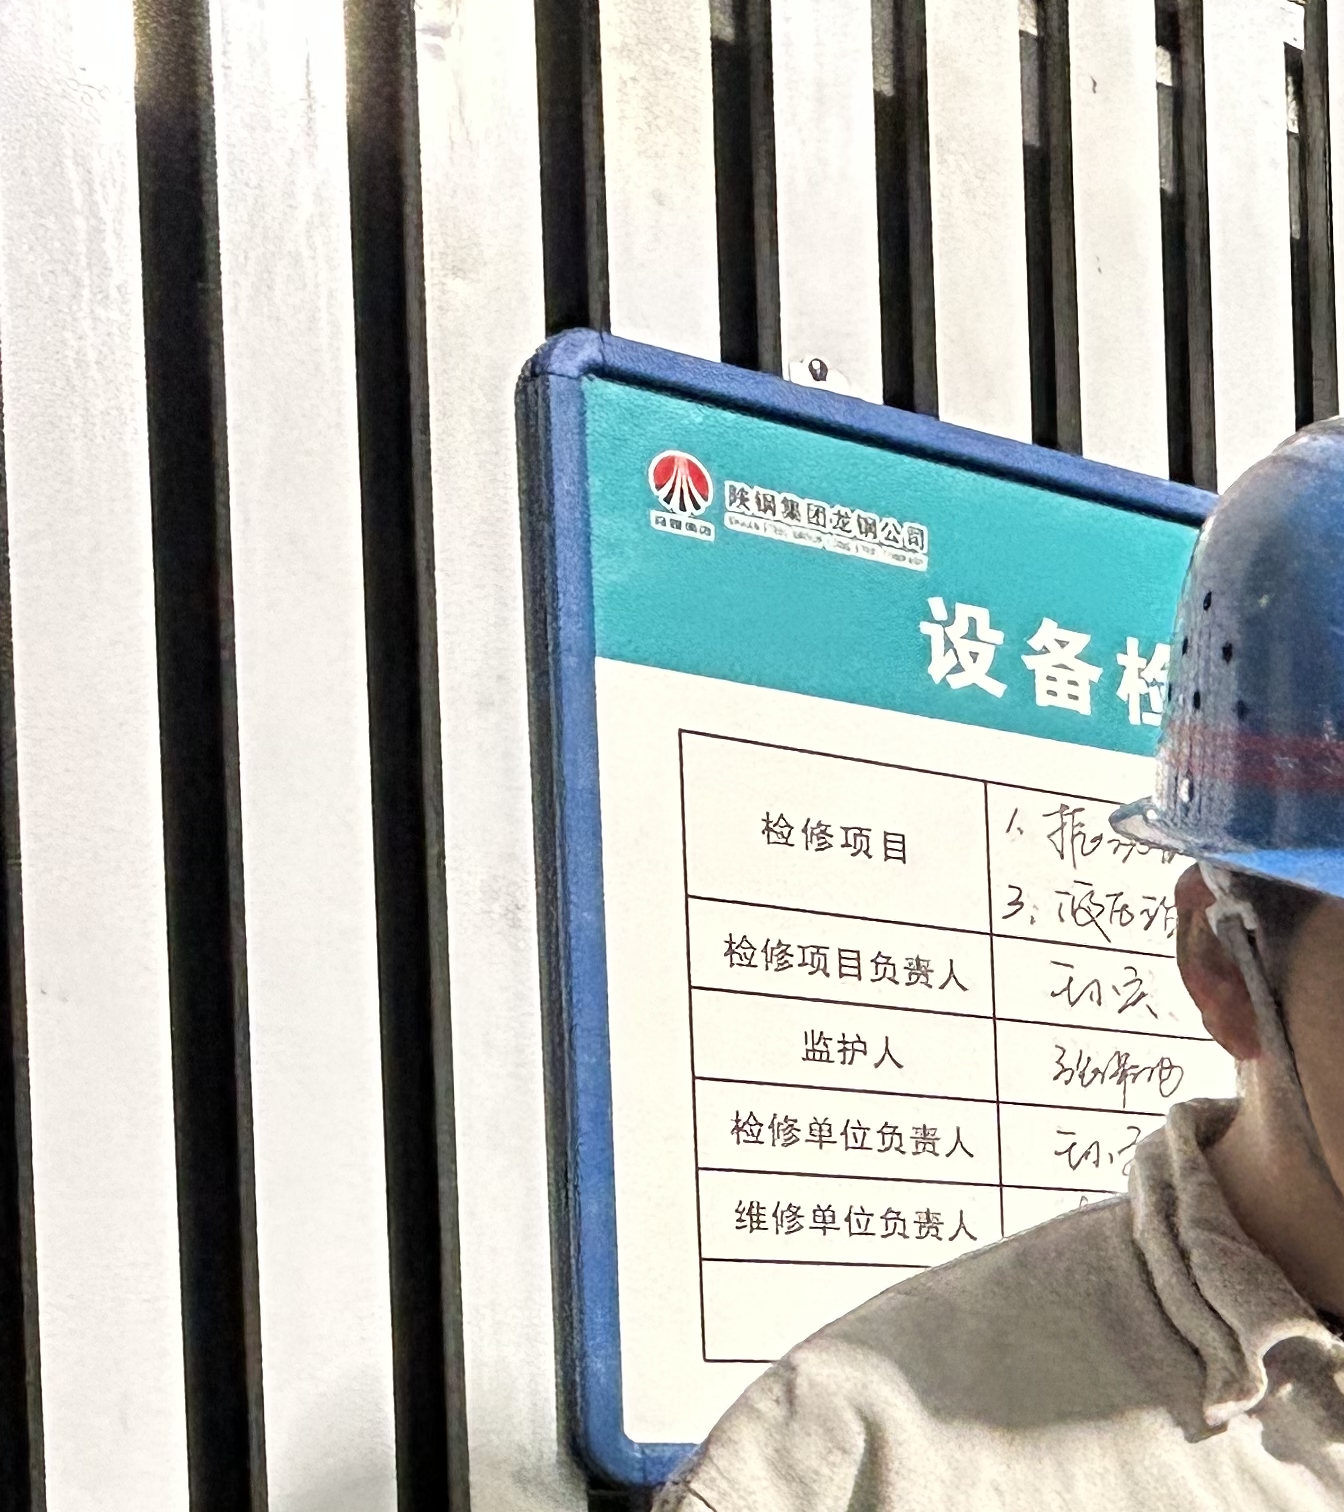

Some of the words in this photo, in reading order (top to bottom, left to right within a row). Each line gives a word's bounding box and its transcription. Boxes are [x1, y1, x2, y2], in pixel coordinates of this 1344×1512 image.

[760, 810, 909, 865] 检修项目
[723, 932, 970, 993] 检修项目负责人
[800, 1029, 906, 1071] 监护人
[730, 1109, 976, 1162] 检修单位负责人
[733, 1201, 979, 1242] 维修单位负责人
